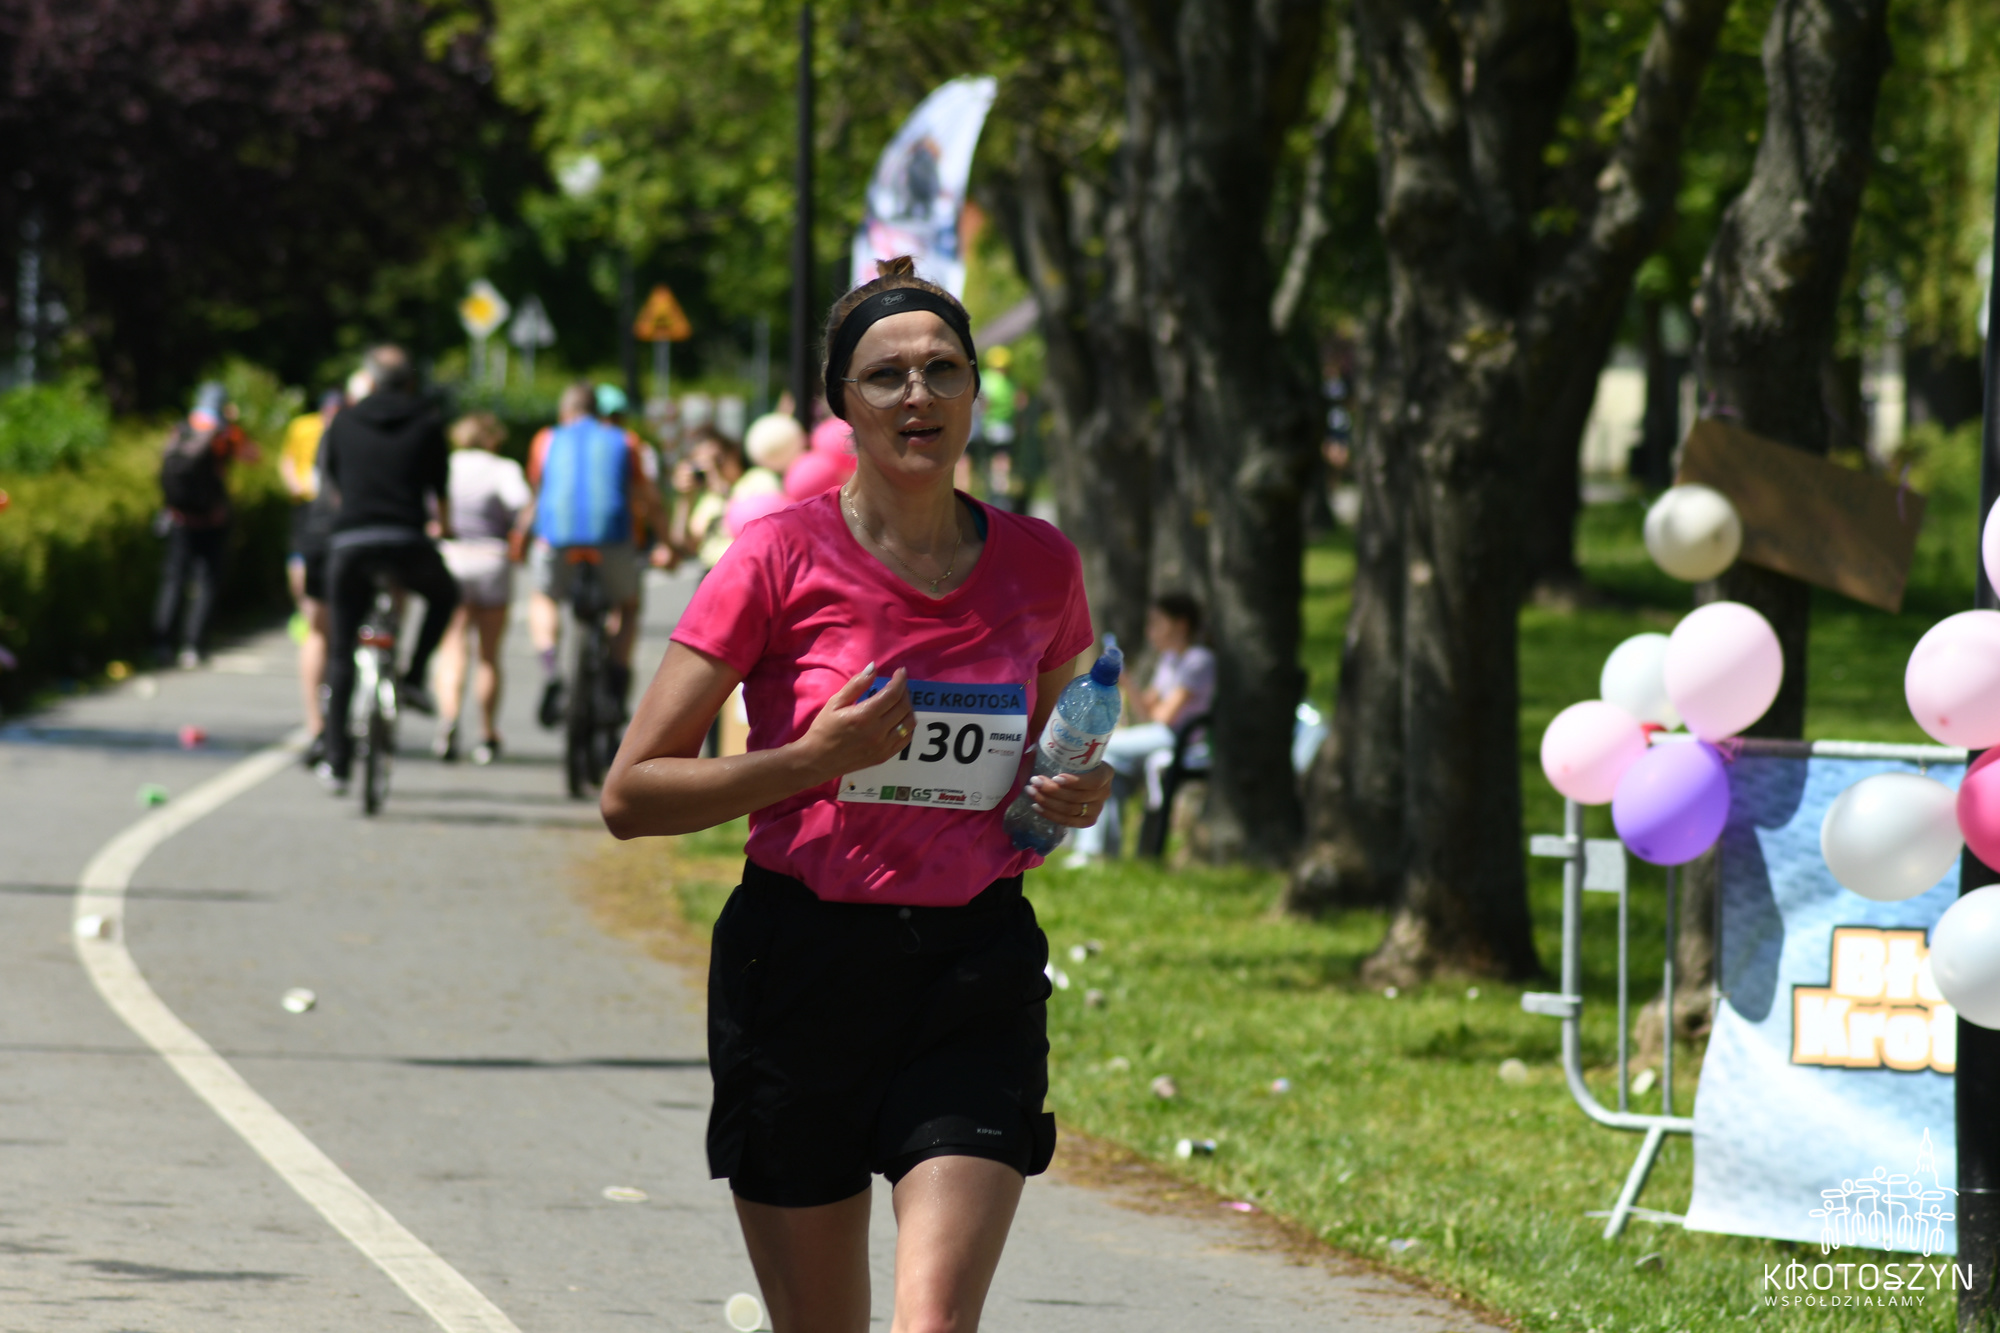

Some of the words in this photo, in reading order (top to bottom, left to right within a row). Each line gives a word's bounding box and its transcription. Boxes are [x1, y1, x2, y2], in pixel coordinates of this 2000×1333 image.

[910, 691, 936, 707] EG
[939, 693, 1020, 709] KROTOSA
[990, 732, 1022, 742] MAHLE
[911, 788, 932, 800] GS
